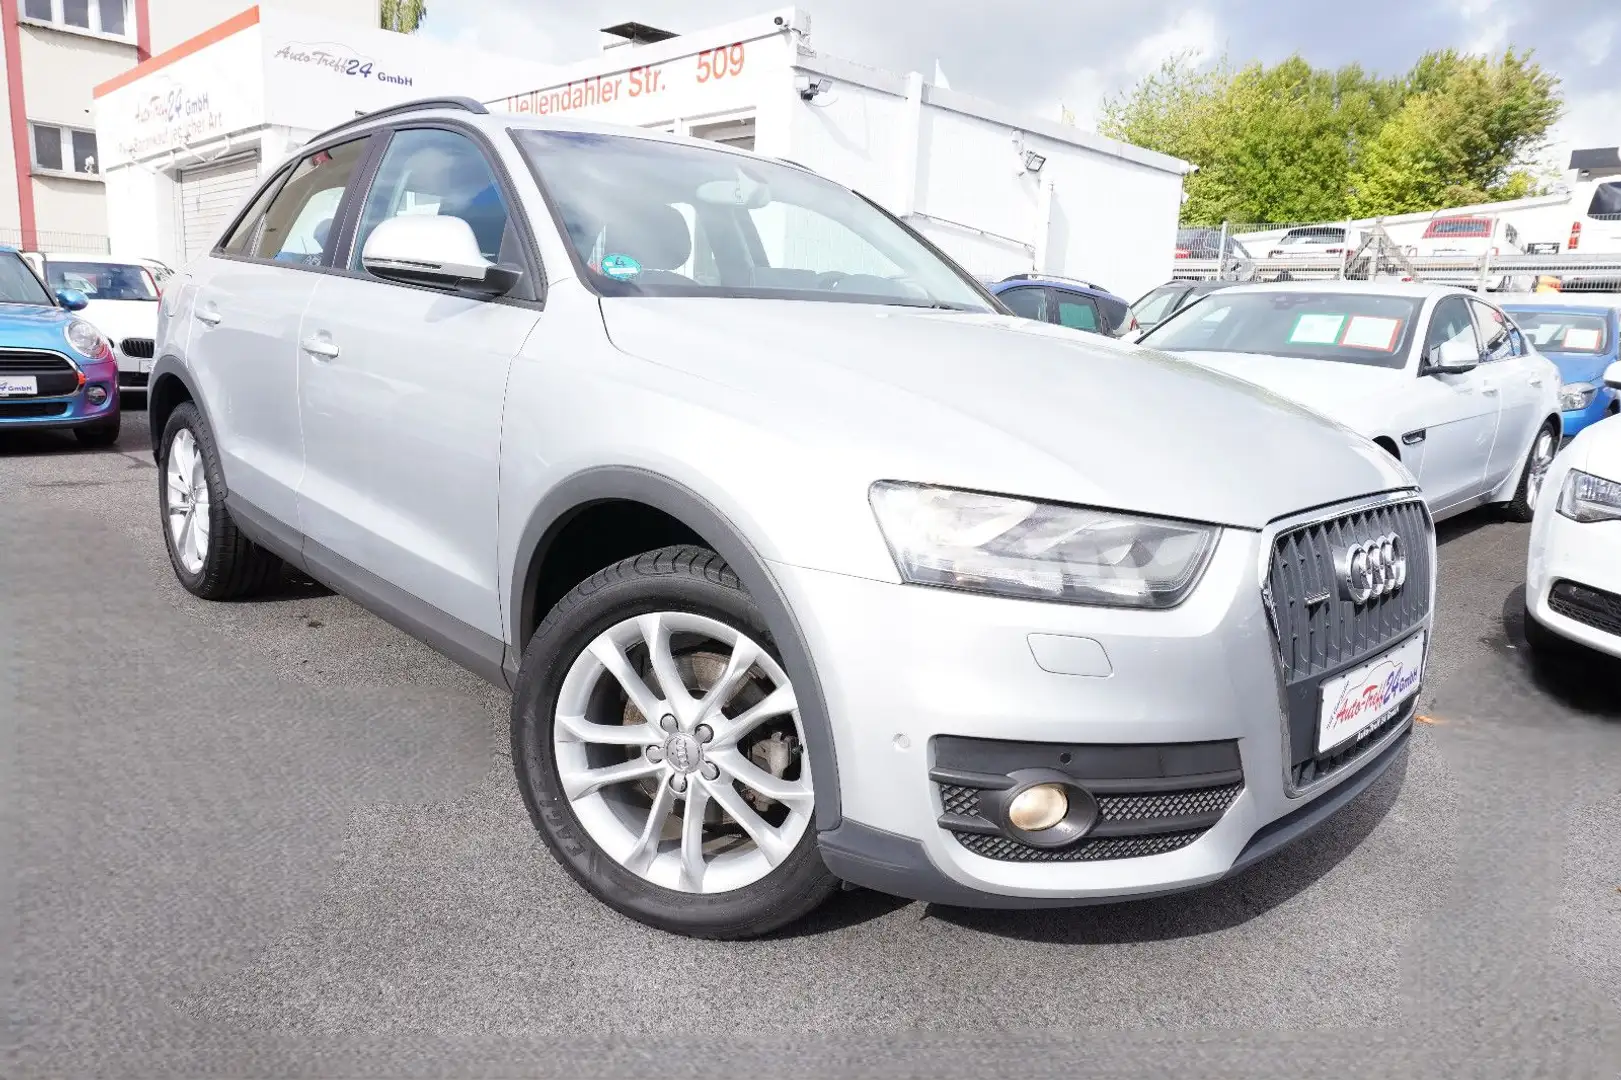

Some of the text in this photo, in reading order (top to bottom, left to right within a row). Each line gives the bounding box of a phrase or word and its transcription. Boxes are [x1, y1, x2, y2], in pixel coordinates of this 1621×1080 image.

[377, 71, 413, 87] GmbH
[628, 66, 666, 98] Str.
[696, 43, 745, 84] 509
[185, 90, 209, 117] GmbH
[207, 110, 223, 131] Art
[1399, 667, 1418, 693] GmbH
